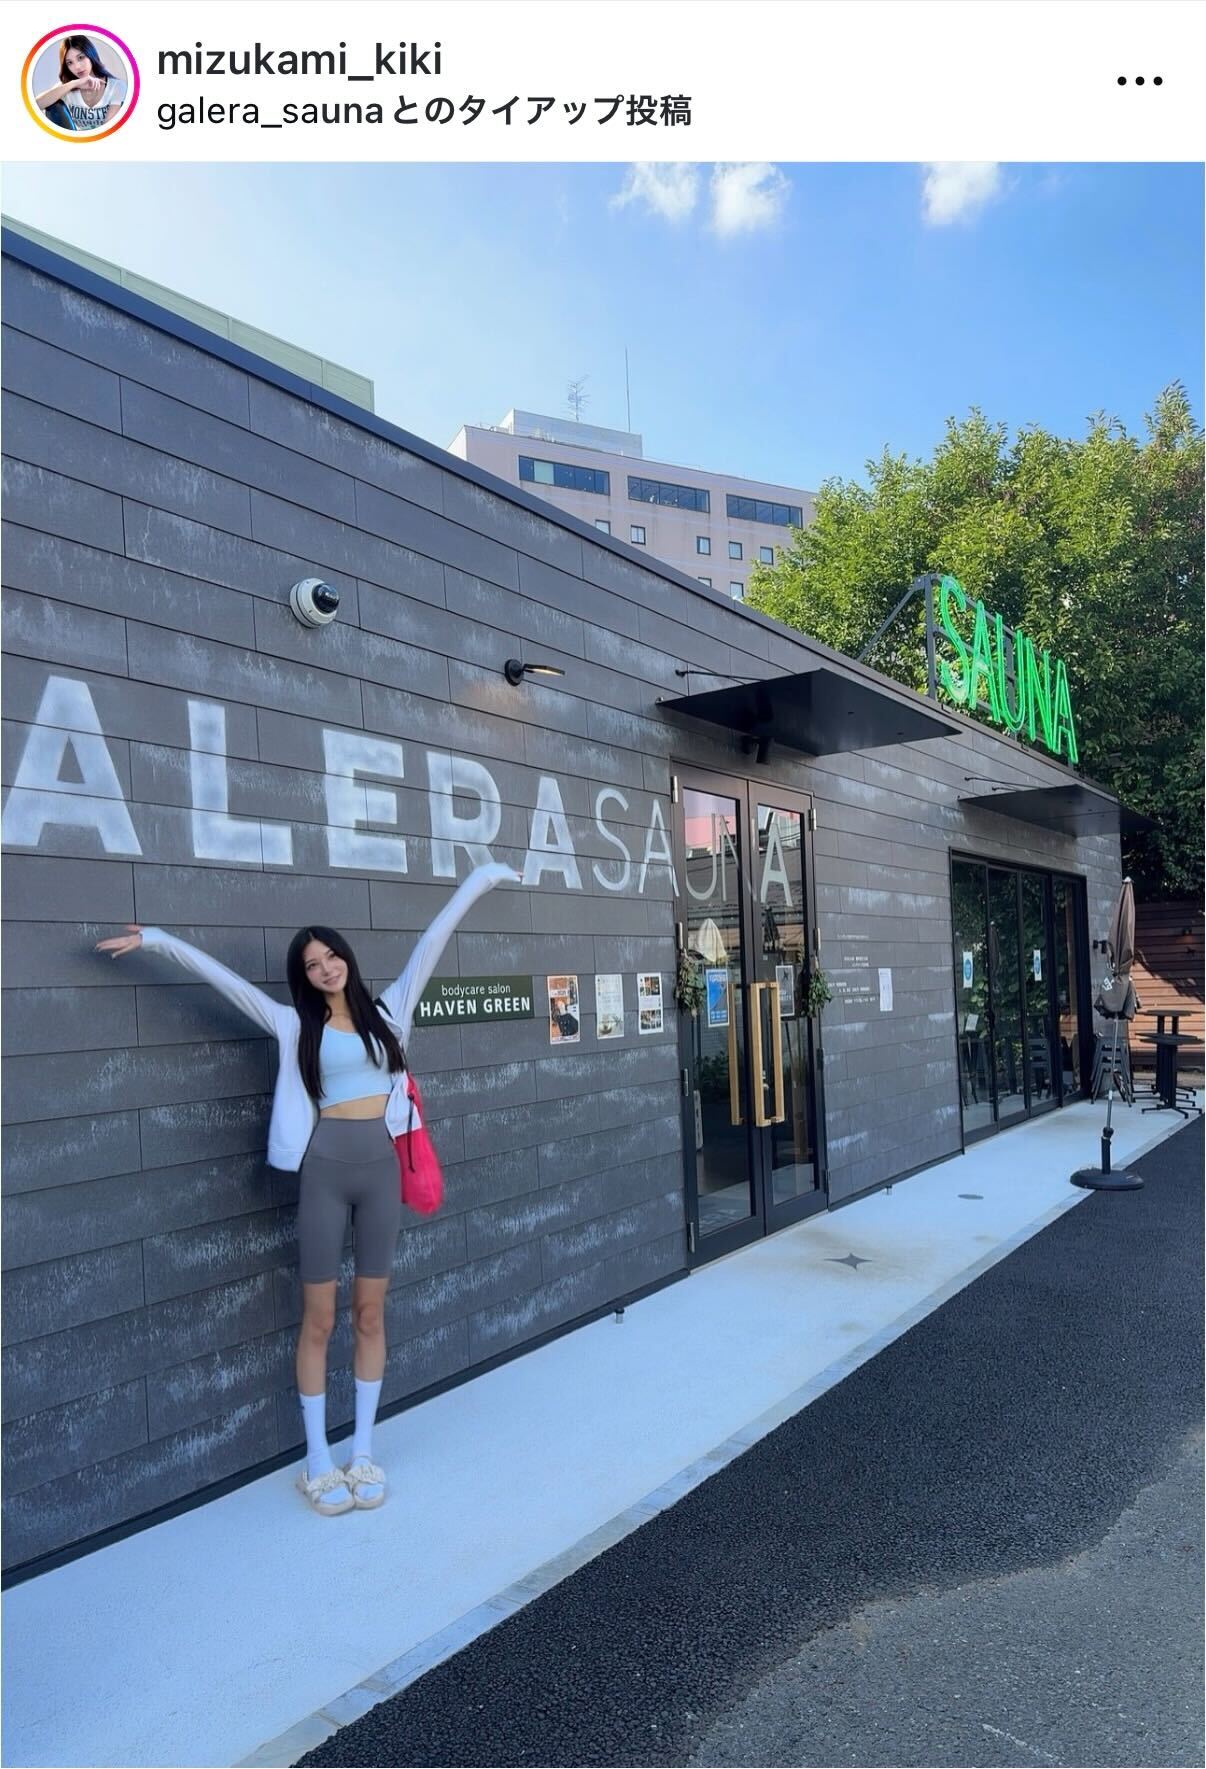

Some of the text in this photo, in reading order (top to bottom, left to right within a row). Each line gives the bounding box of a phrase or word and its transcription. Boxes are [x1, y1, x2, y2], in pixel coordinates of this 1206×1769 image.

[940, 575, 1078, 764] SAUNA
[441, 983, 512, 998] bodycare salon
[420, 996, 531, 1018] HAVEN GREEN
